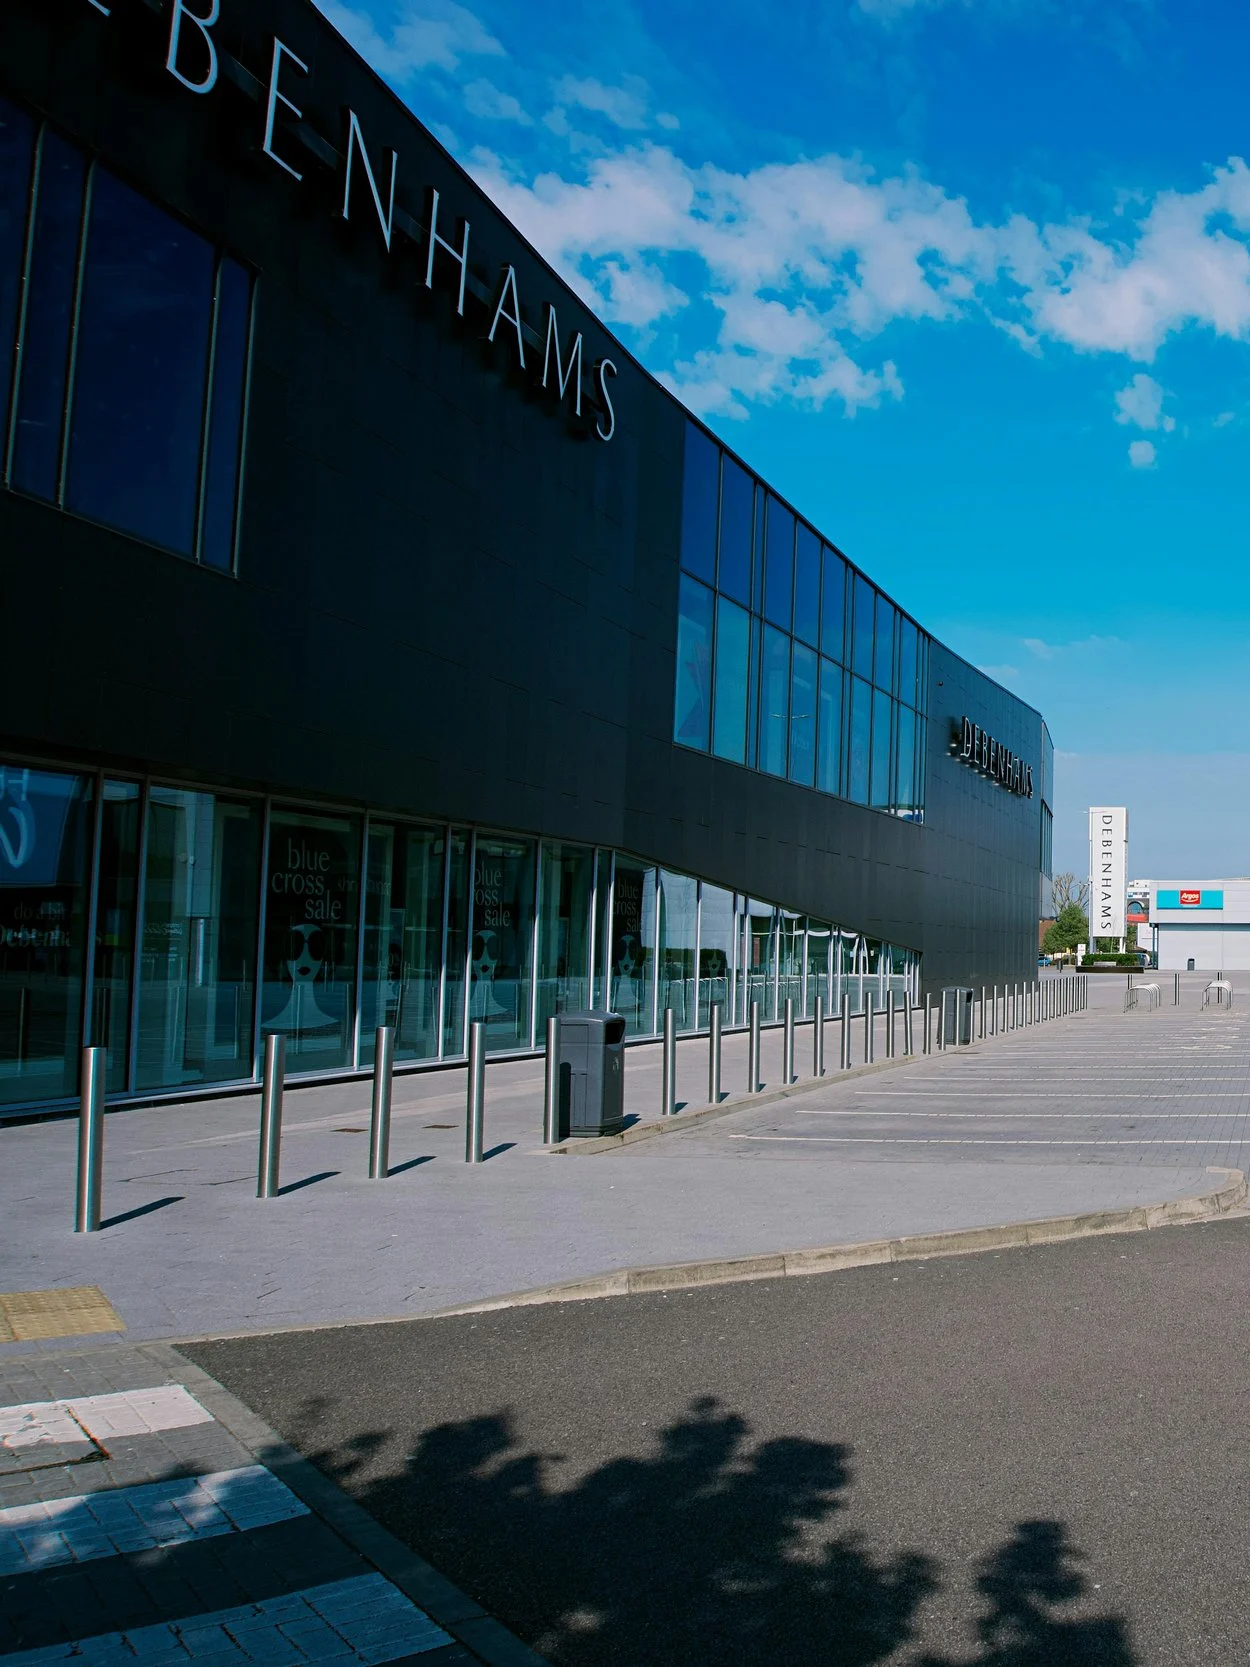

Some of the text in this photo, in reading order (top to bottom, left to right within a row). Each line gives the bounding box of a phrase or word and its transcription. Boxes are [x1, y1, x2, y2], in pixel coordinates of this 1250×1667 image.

[86, 0, 617, 441] BENHAMS
[961, 716, 1033, 799] DEBENHAMS
[288, 837, 331, 872] blue
[271, 872, 325, 895] cross
[1101, 815, 1113, 929] DEBENHAMS
[304, 889, 342, 920] sale
[1181, 892, 1199, 902] Argos
[484, 901, 511, 927] sale
